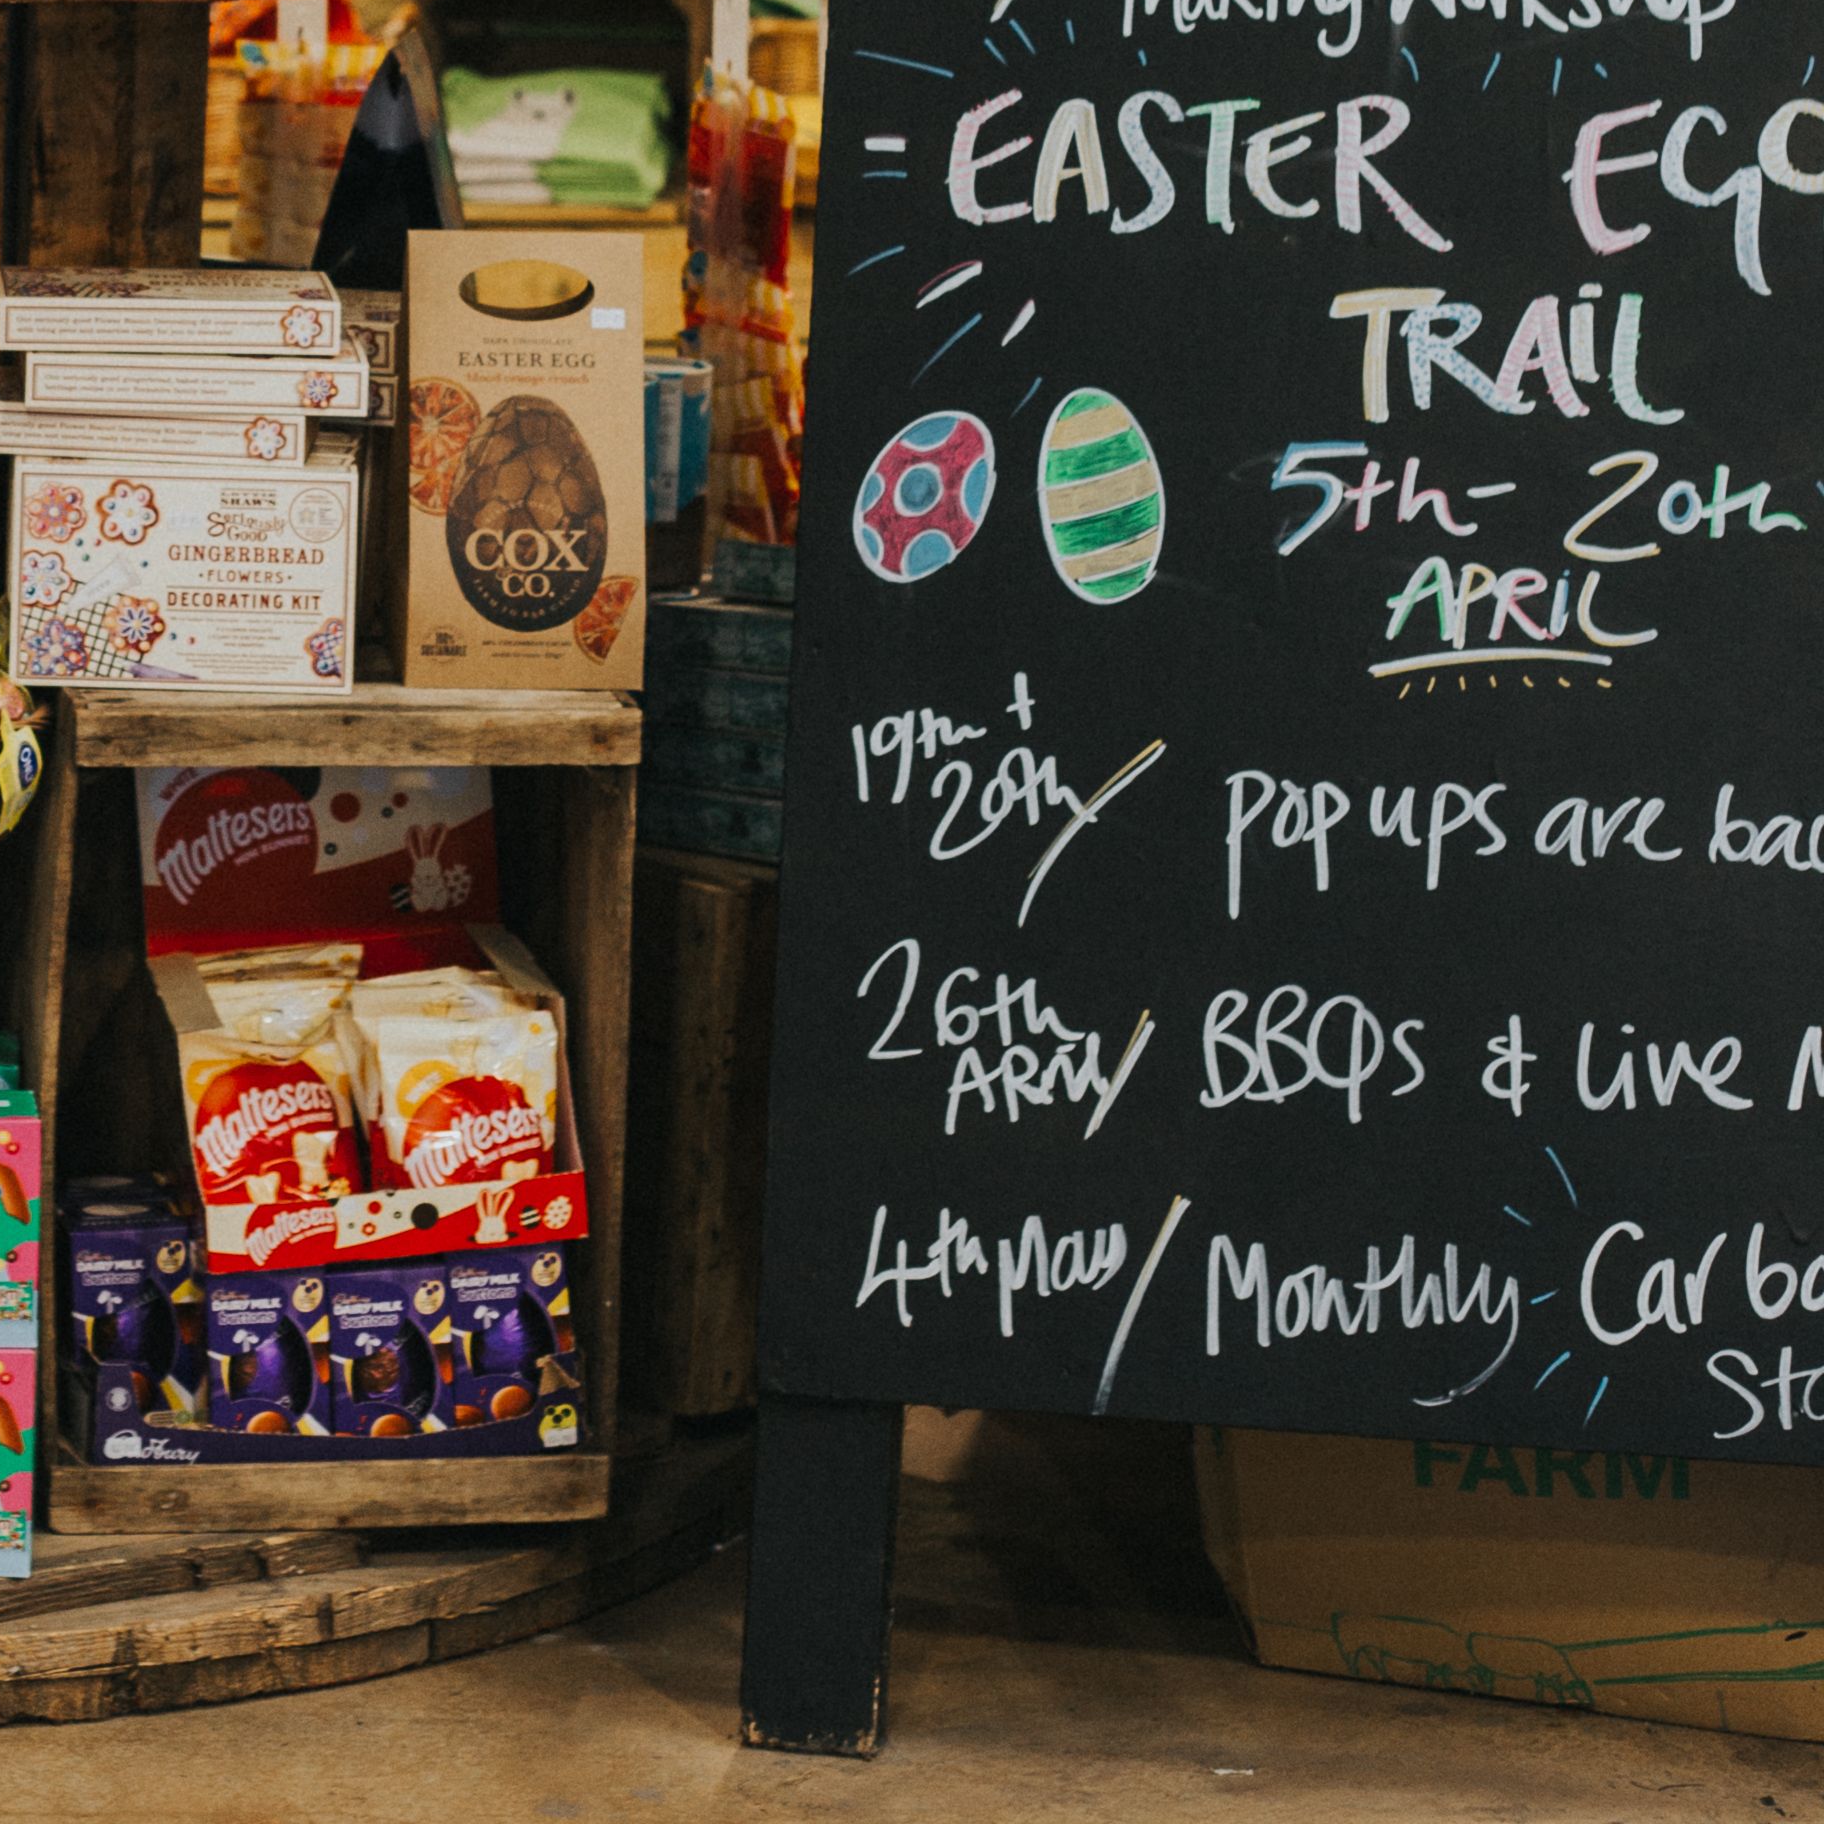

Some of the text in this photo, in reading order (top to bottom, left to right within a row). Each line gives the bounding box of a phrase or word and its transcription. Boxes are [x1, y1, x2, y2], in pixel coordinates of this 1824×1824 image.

[946, 88, 1454, 253] EASTER
[458, 351, 597, 369] EASTER EGG
[220, 497, 277, 507] SHAW'S
[1563, 451, 1807, 561] 20th
[168, 544, 325, 565] GINGERBREAD
[465, 528, 590, 573] COX
[167, 591, 322, 611] DECORATING KIT
[206, 569, 285, 585] FLOWERS
[158, 801, 310, 906] Maltesers
[1534, 794, 1684, 866] are
[1198, 983, 1426, 1124] BBQs
[194, 1080, 332, 1177] Maltesers
[402, 1106, 543, 1189] Maltesers
[245, 1206, 336, 1266] Maltesers
[76, 1258, 145, 1273] DAIRY MILK
[450, 1272, 521, 1289] DAIRY MILK
[211, 1297, 282, 1312] DAIRY MILK
[333, 1300, 404, 1316] DAIRY MILK
[855, 1203, 987, 1328] 4th
[1205, 1232, 1521, 1408] Monthly
[1580, 1221, 1728, 1346] Car
[1411, 1439, 1692, 1502] FARM
